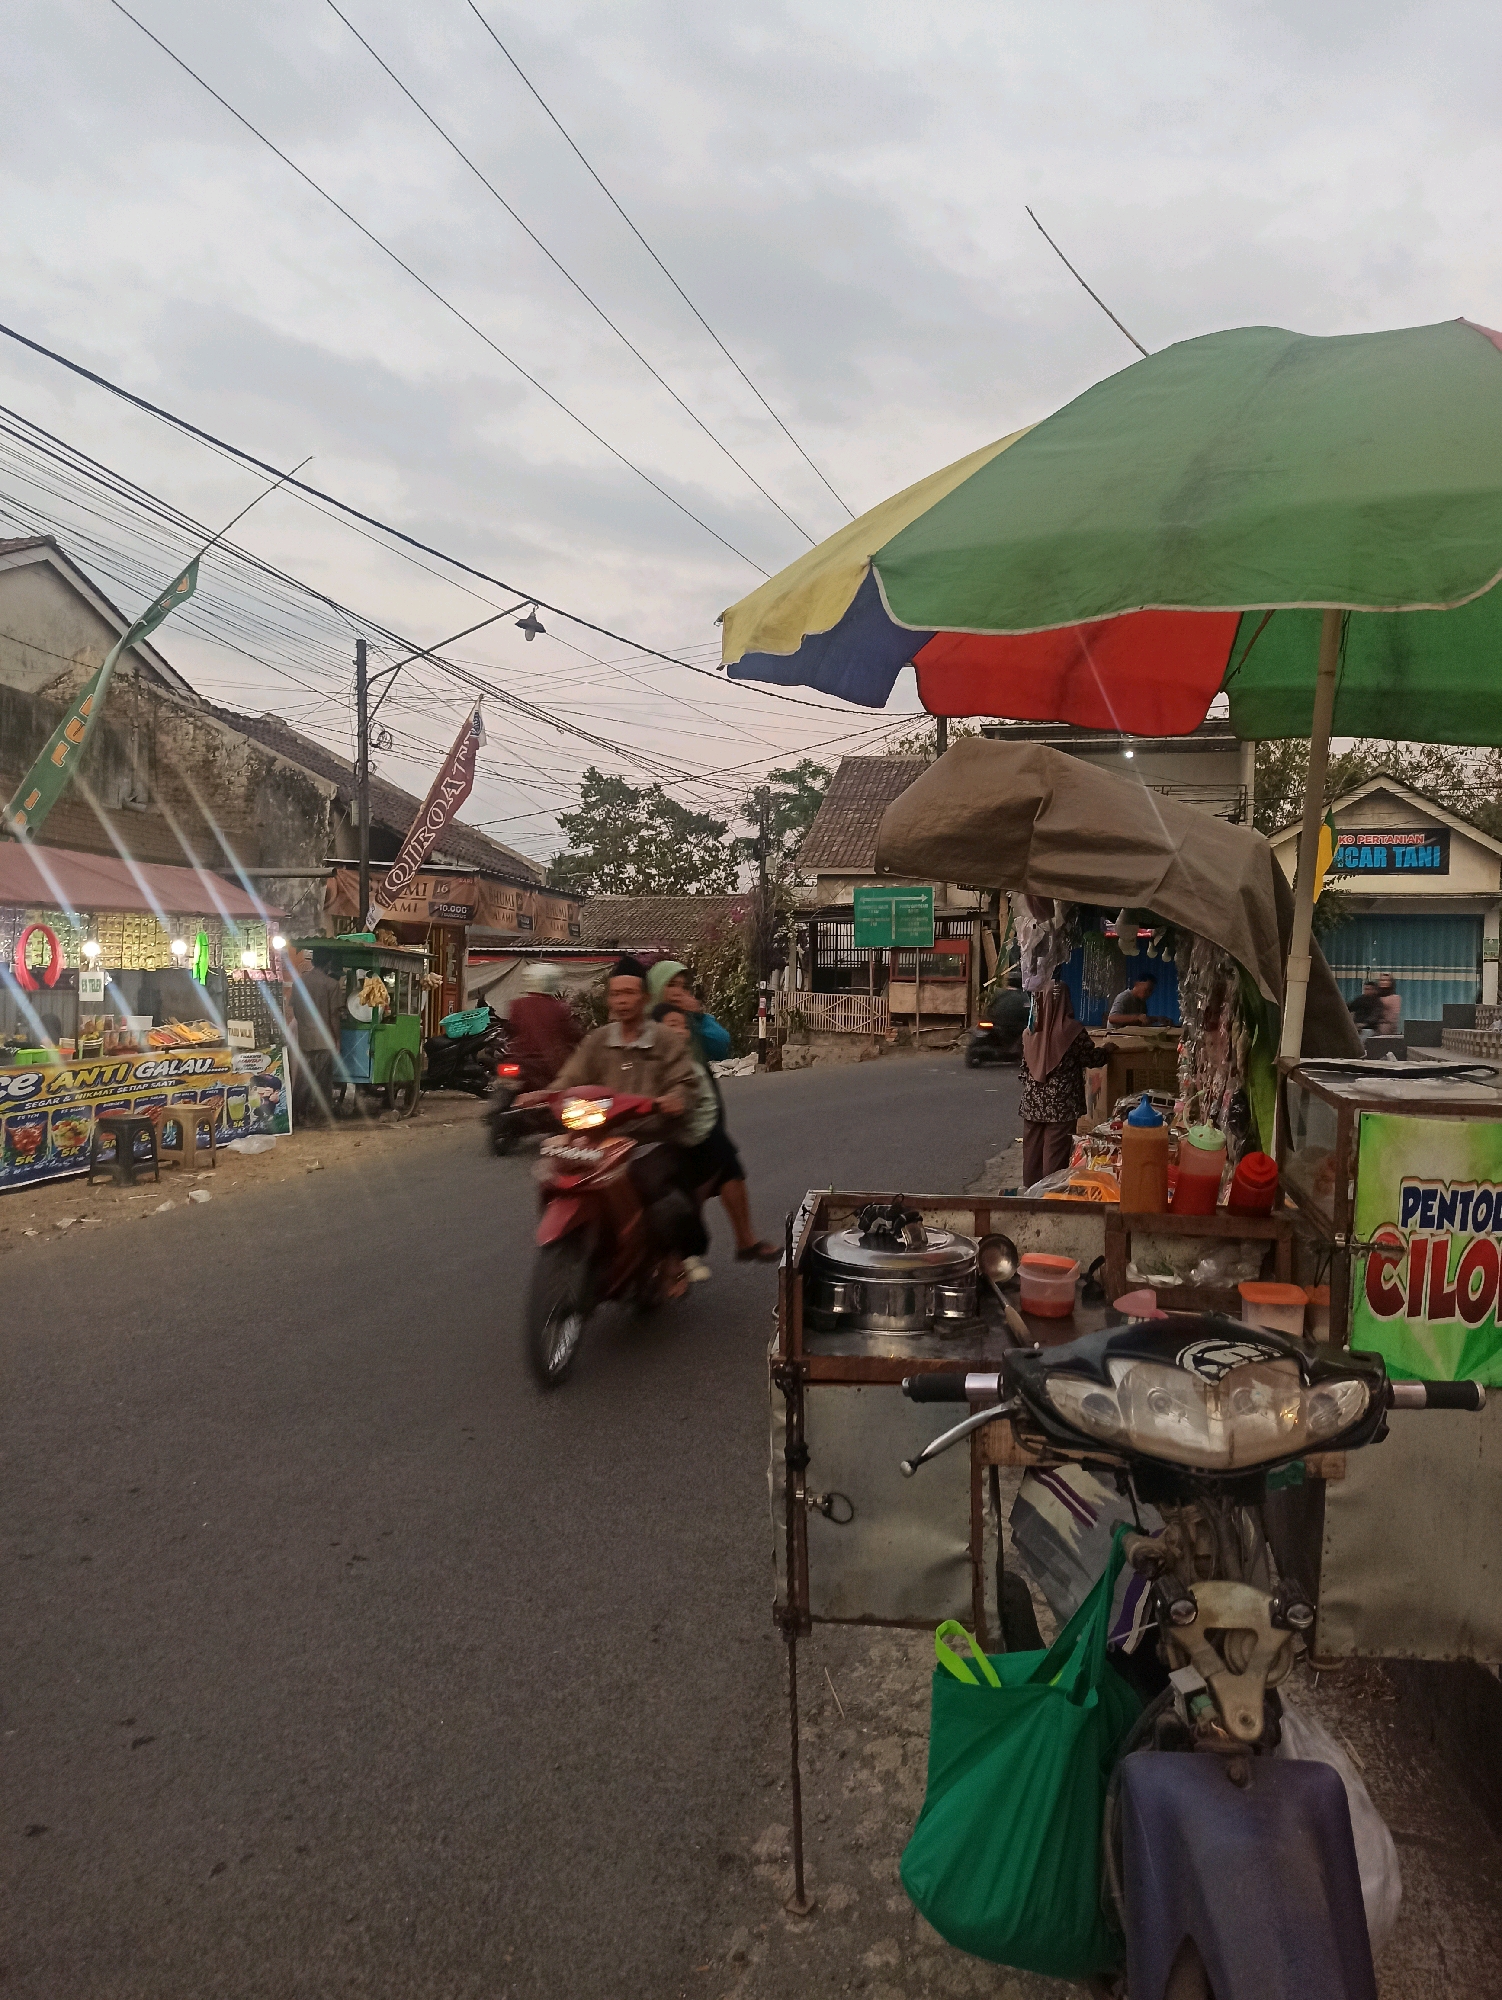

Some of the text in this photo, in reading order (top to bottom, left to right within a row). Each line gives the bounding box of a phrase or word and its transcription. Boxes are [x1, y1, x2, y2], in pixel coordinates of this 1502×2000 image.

[1338, 834, 1425, 845] KO PERTANIAN
[1393, 845, 1441, 868] TANI
[50, 1063, 130, 1092] ANTI
[24, 1098, 59, 1109] SEGAR
[63, 1096, 71, 1104] &
[75, 1088, 114, 1100] NIKMAT
[117, 1083, 149, 1094] SETIAP
[15, 1155, 36, 1166] 5K
[61, 1147, 79, 1158] 5K
[1364, 1229, 1502, 1325] CILO
